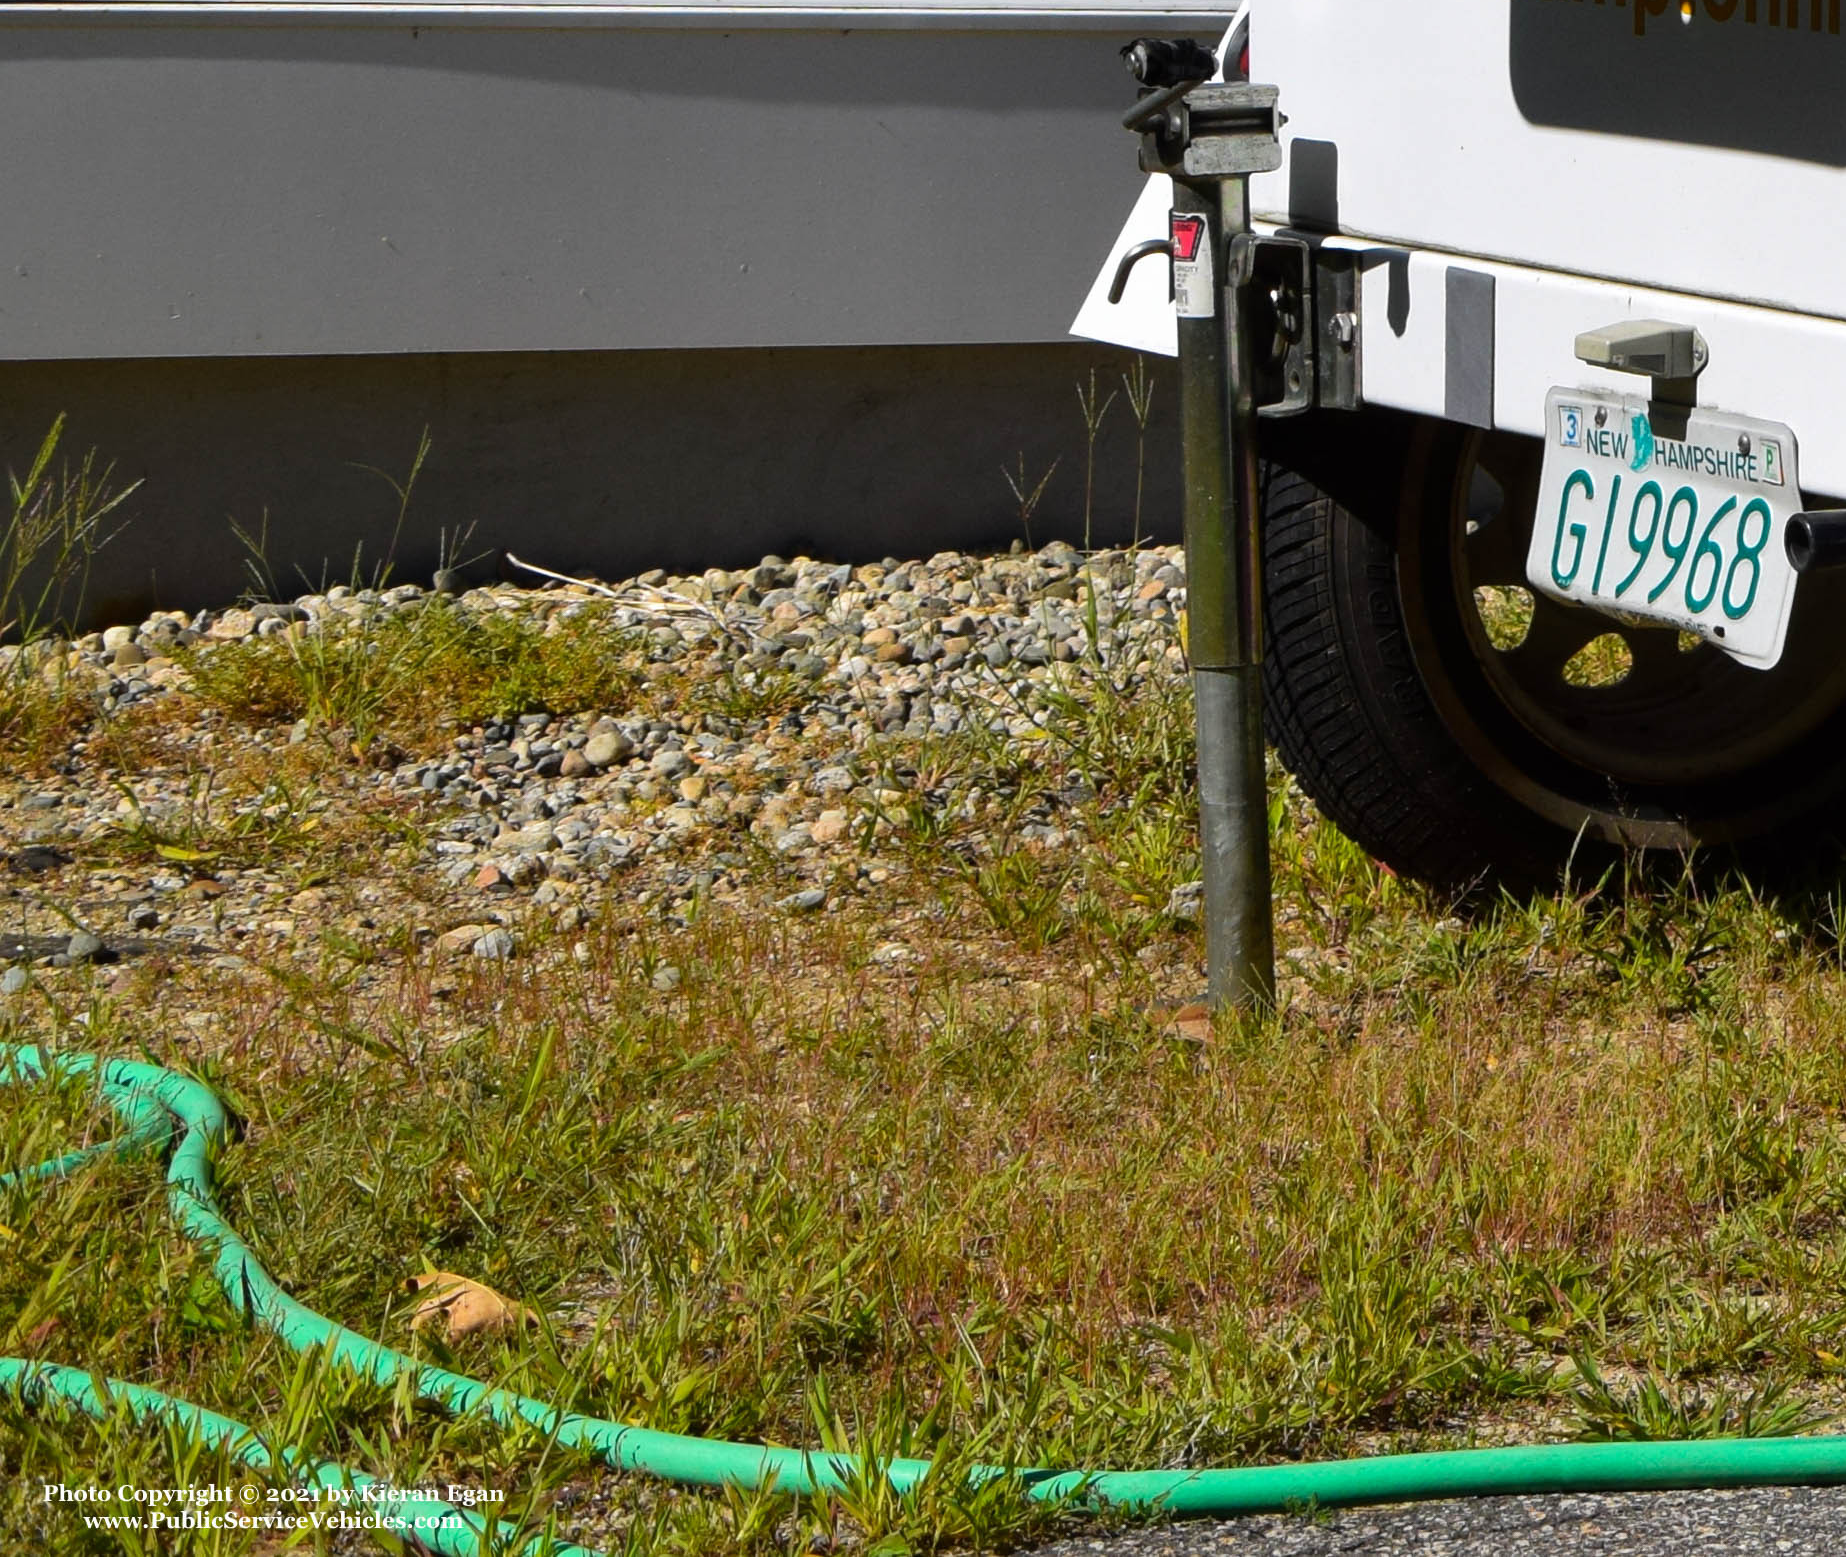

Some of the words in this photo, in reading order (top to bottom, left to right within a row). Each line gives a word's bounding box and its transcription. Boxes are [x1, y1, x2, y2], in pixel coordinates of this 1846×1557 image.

[1567, 413, 1577, 440] 3
[1586, 429, 1628, 459] NEW
[1654, 441, 1758, 483] HAMPSHIRE
